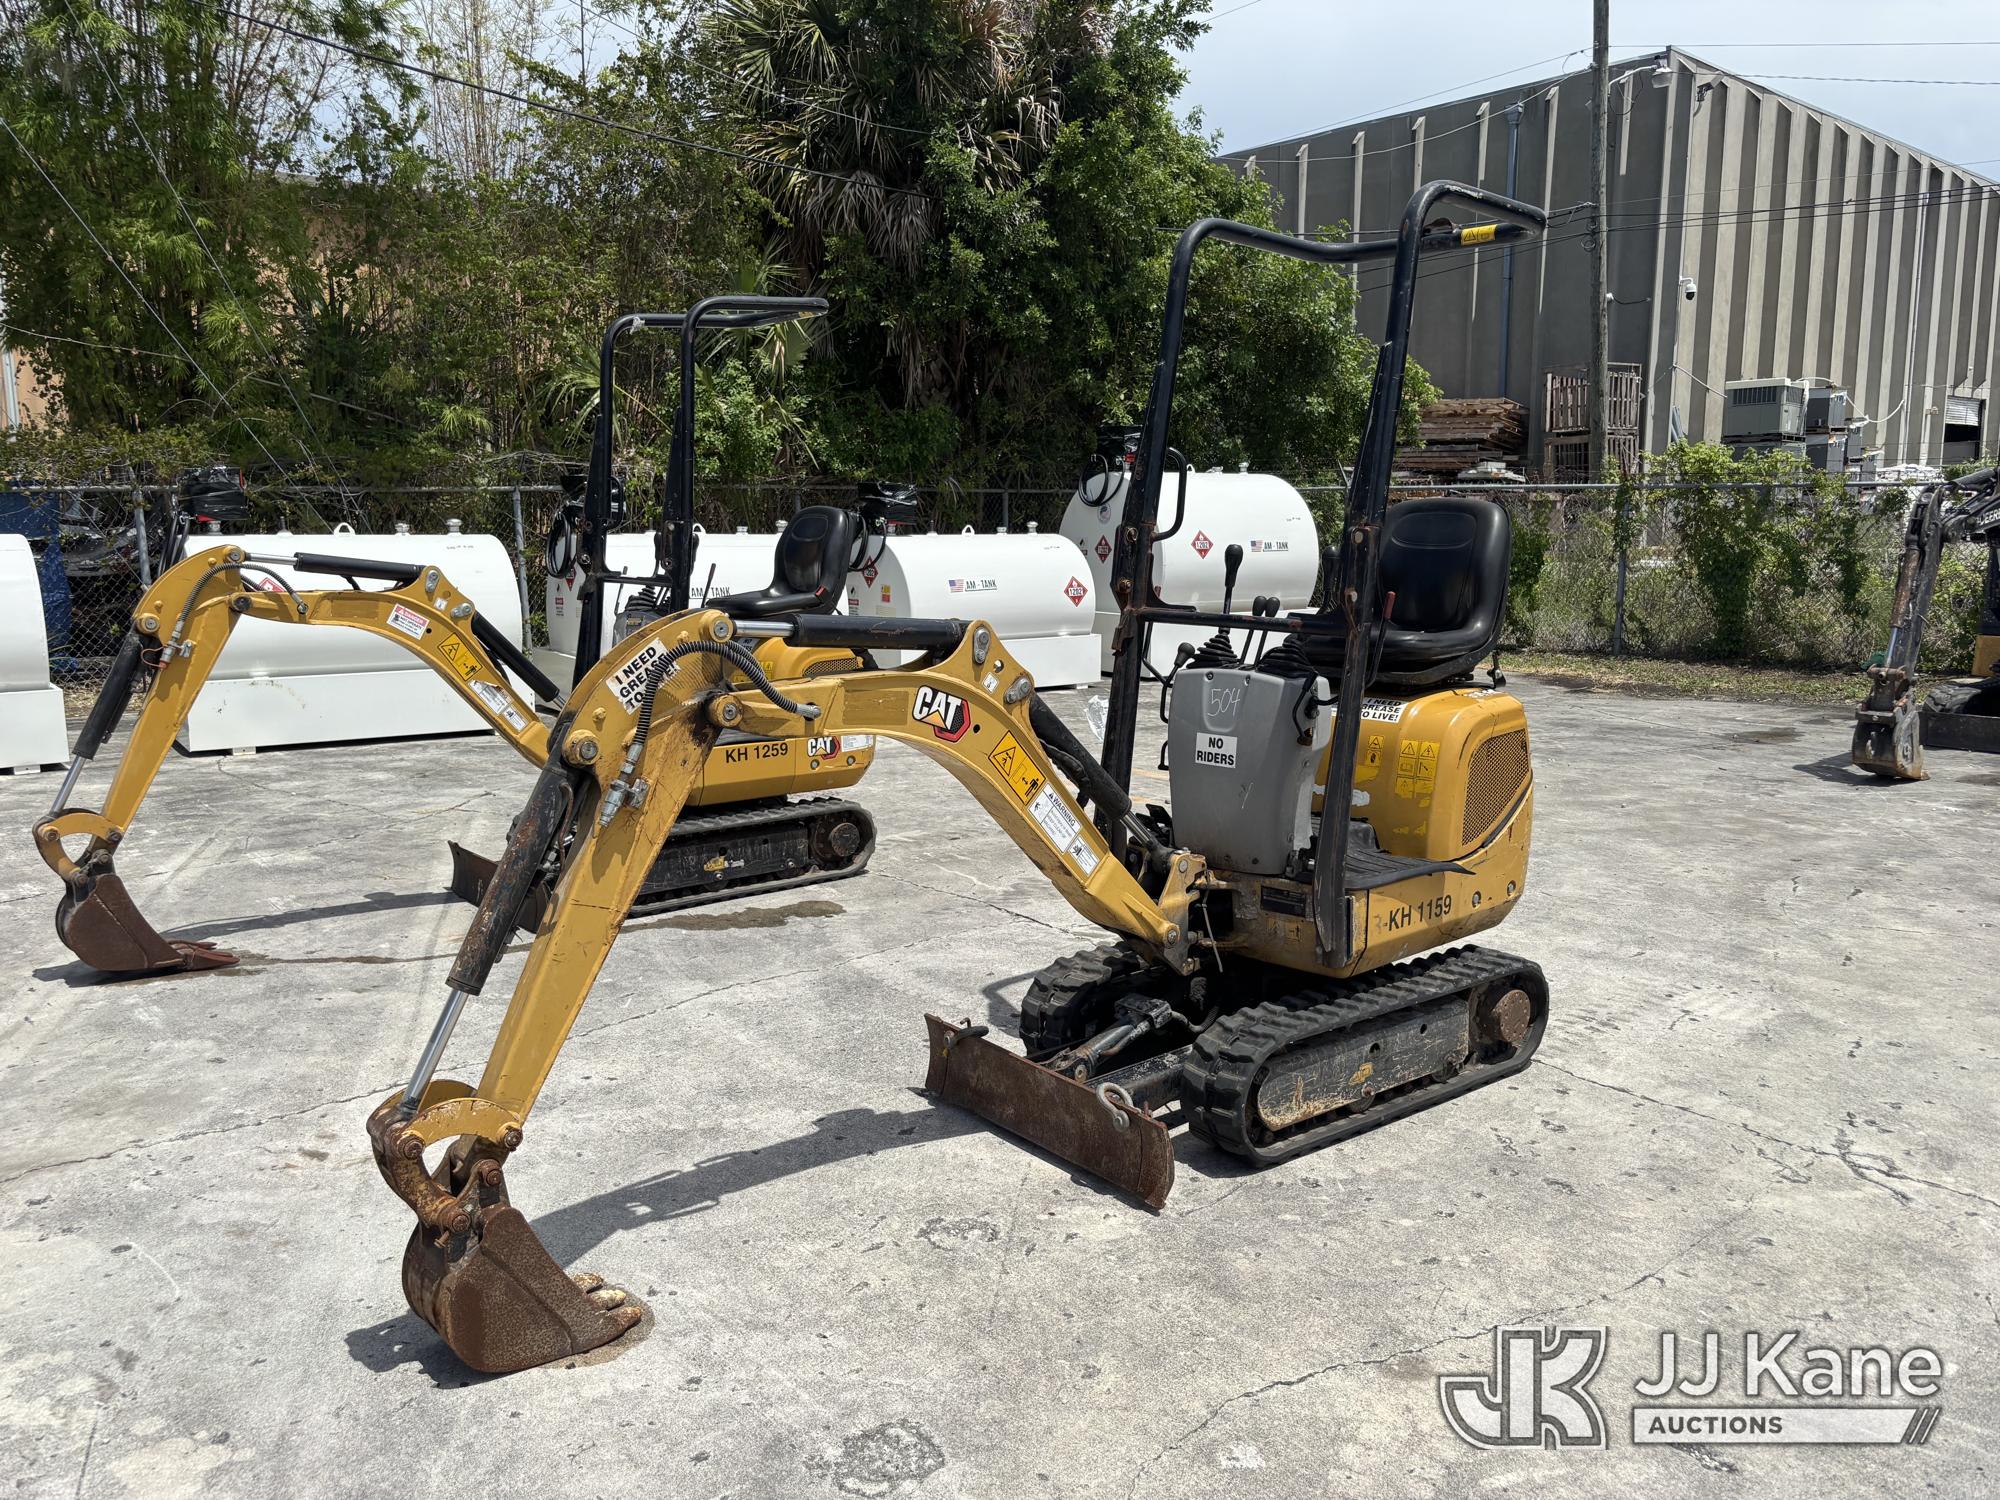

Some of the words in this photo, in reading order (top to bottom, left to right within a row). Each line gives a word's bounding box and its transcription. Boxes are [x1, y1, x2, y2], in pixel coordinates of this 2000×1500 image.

[1264, 541, 1272, 549] AM
[1276, 541, 1288, 549] TANK
[691, 587, 704, 597] AM
[711, 586, 730, 597] TANK
[965, 580, 977, 590] AM
[981, 579, 997, 589] TANK
[1068, 588, 1082, 596] 1202
[615, 675, 624, 685] I
[622, 646, 657, 678] NEED
[625, 691, 644, 708] TO
[1207, 688, 1240, 717] 504
[1374, 699, 1402, 707] NEED
[913, 686, 962, 730] CAT
[1373, 712, 1399, 721] LIVE!
[807, 736, 832, 757] CAT
[1208, 737, 1224, 749] NO
[725, 748, 748, 763] KH
[754, 743, 788, 759] 1259
[1196, 750, 1235, 766] RIDERS
[1052, 796, 1076, 826] WARNING
[1418, 894, 1452, 922] 1159
